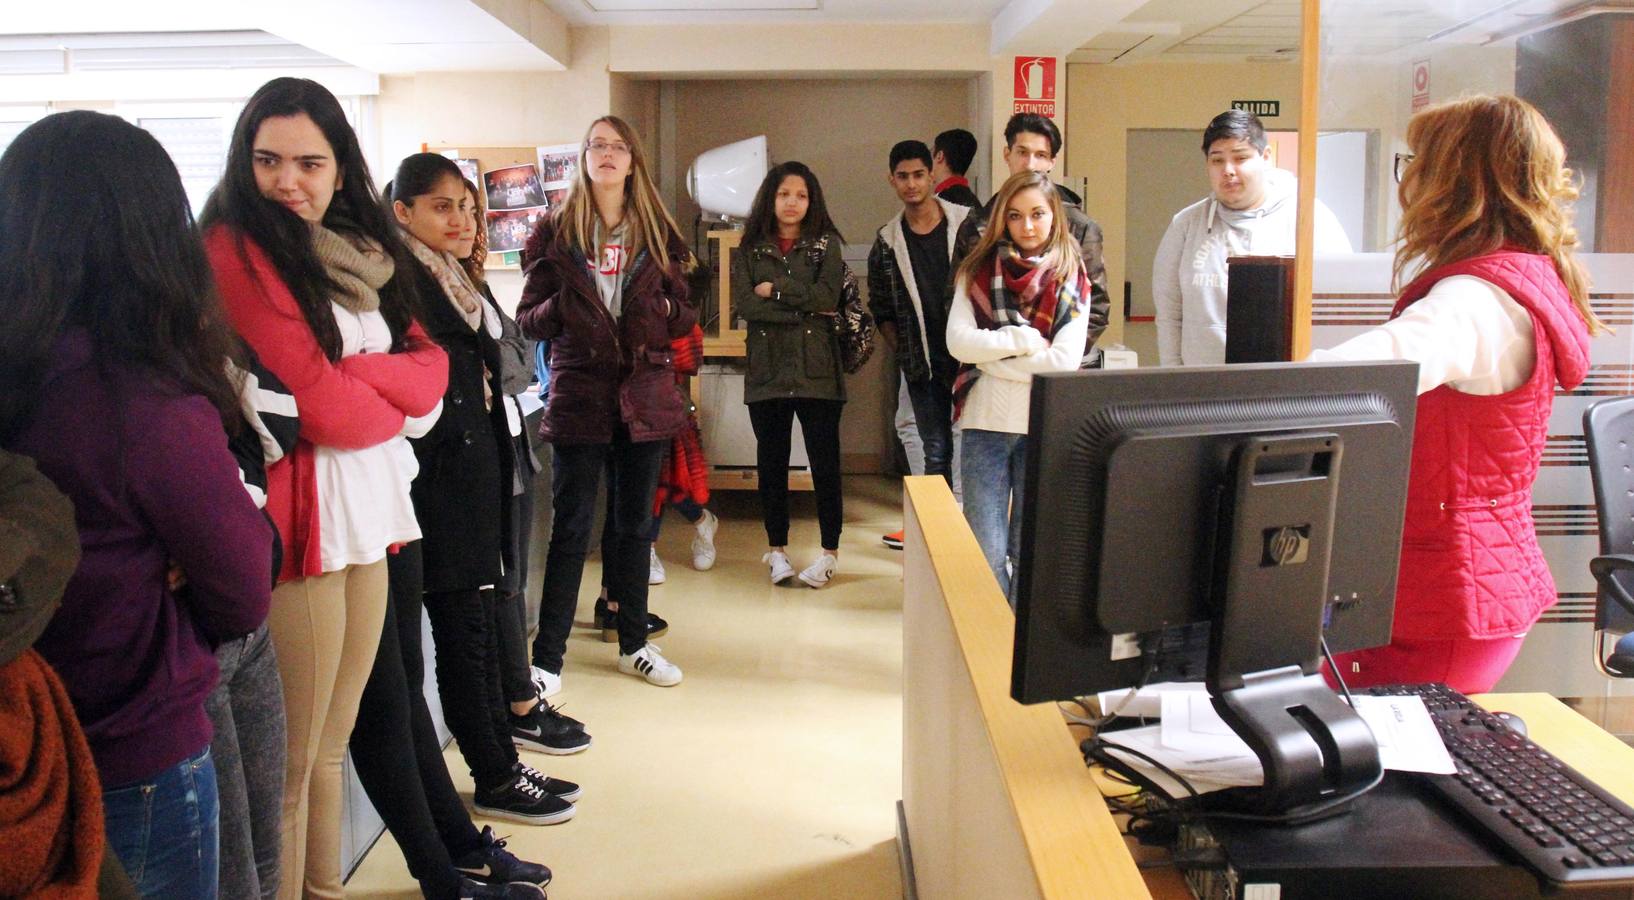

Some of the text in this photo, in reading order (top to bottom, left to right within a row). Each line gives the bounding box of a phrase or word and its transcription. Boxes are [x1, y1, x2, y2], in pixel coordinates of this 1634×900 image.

[1014, 103, 1054, 115] EXTINTOR
[1234, 103, 1276, 114] SALIDA
[1274, 527, 1299, 567] hp
